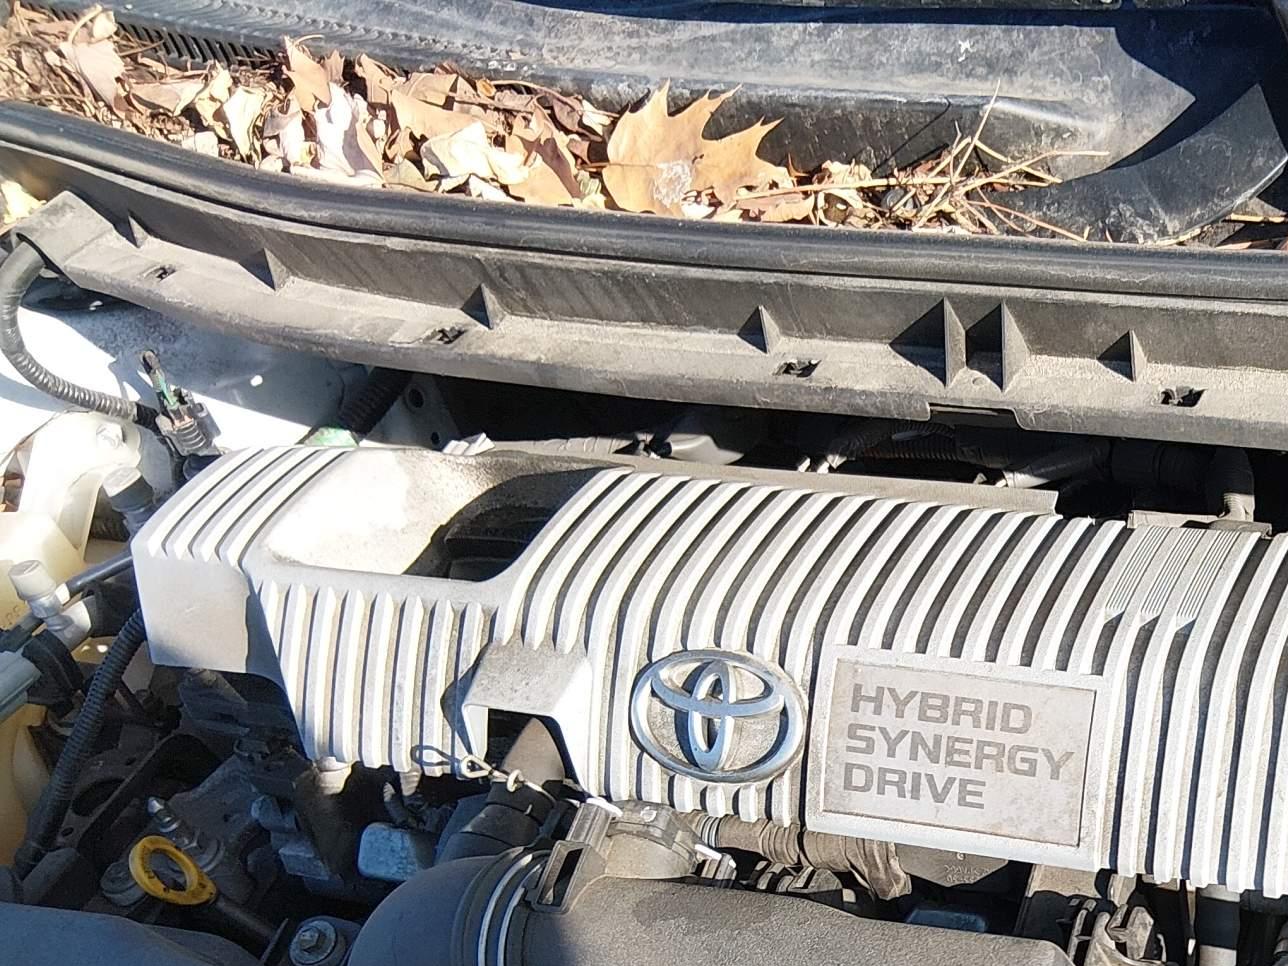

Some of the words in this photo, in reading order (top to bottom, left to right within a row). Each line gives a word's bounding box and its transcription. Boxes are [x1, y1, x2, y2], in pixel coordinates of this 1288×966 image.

[850, 683, 1032, 734] HYBRID
[846, 723, 1074, 780] SYNERGY
[843, 762, 986, 809] DRIVE
